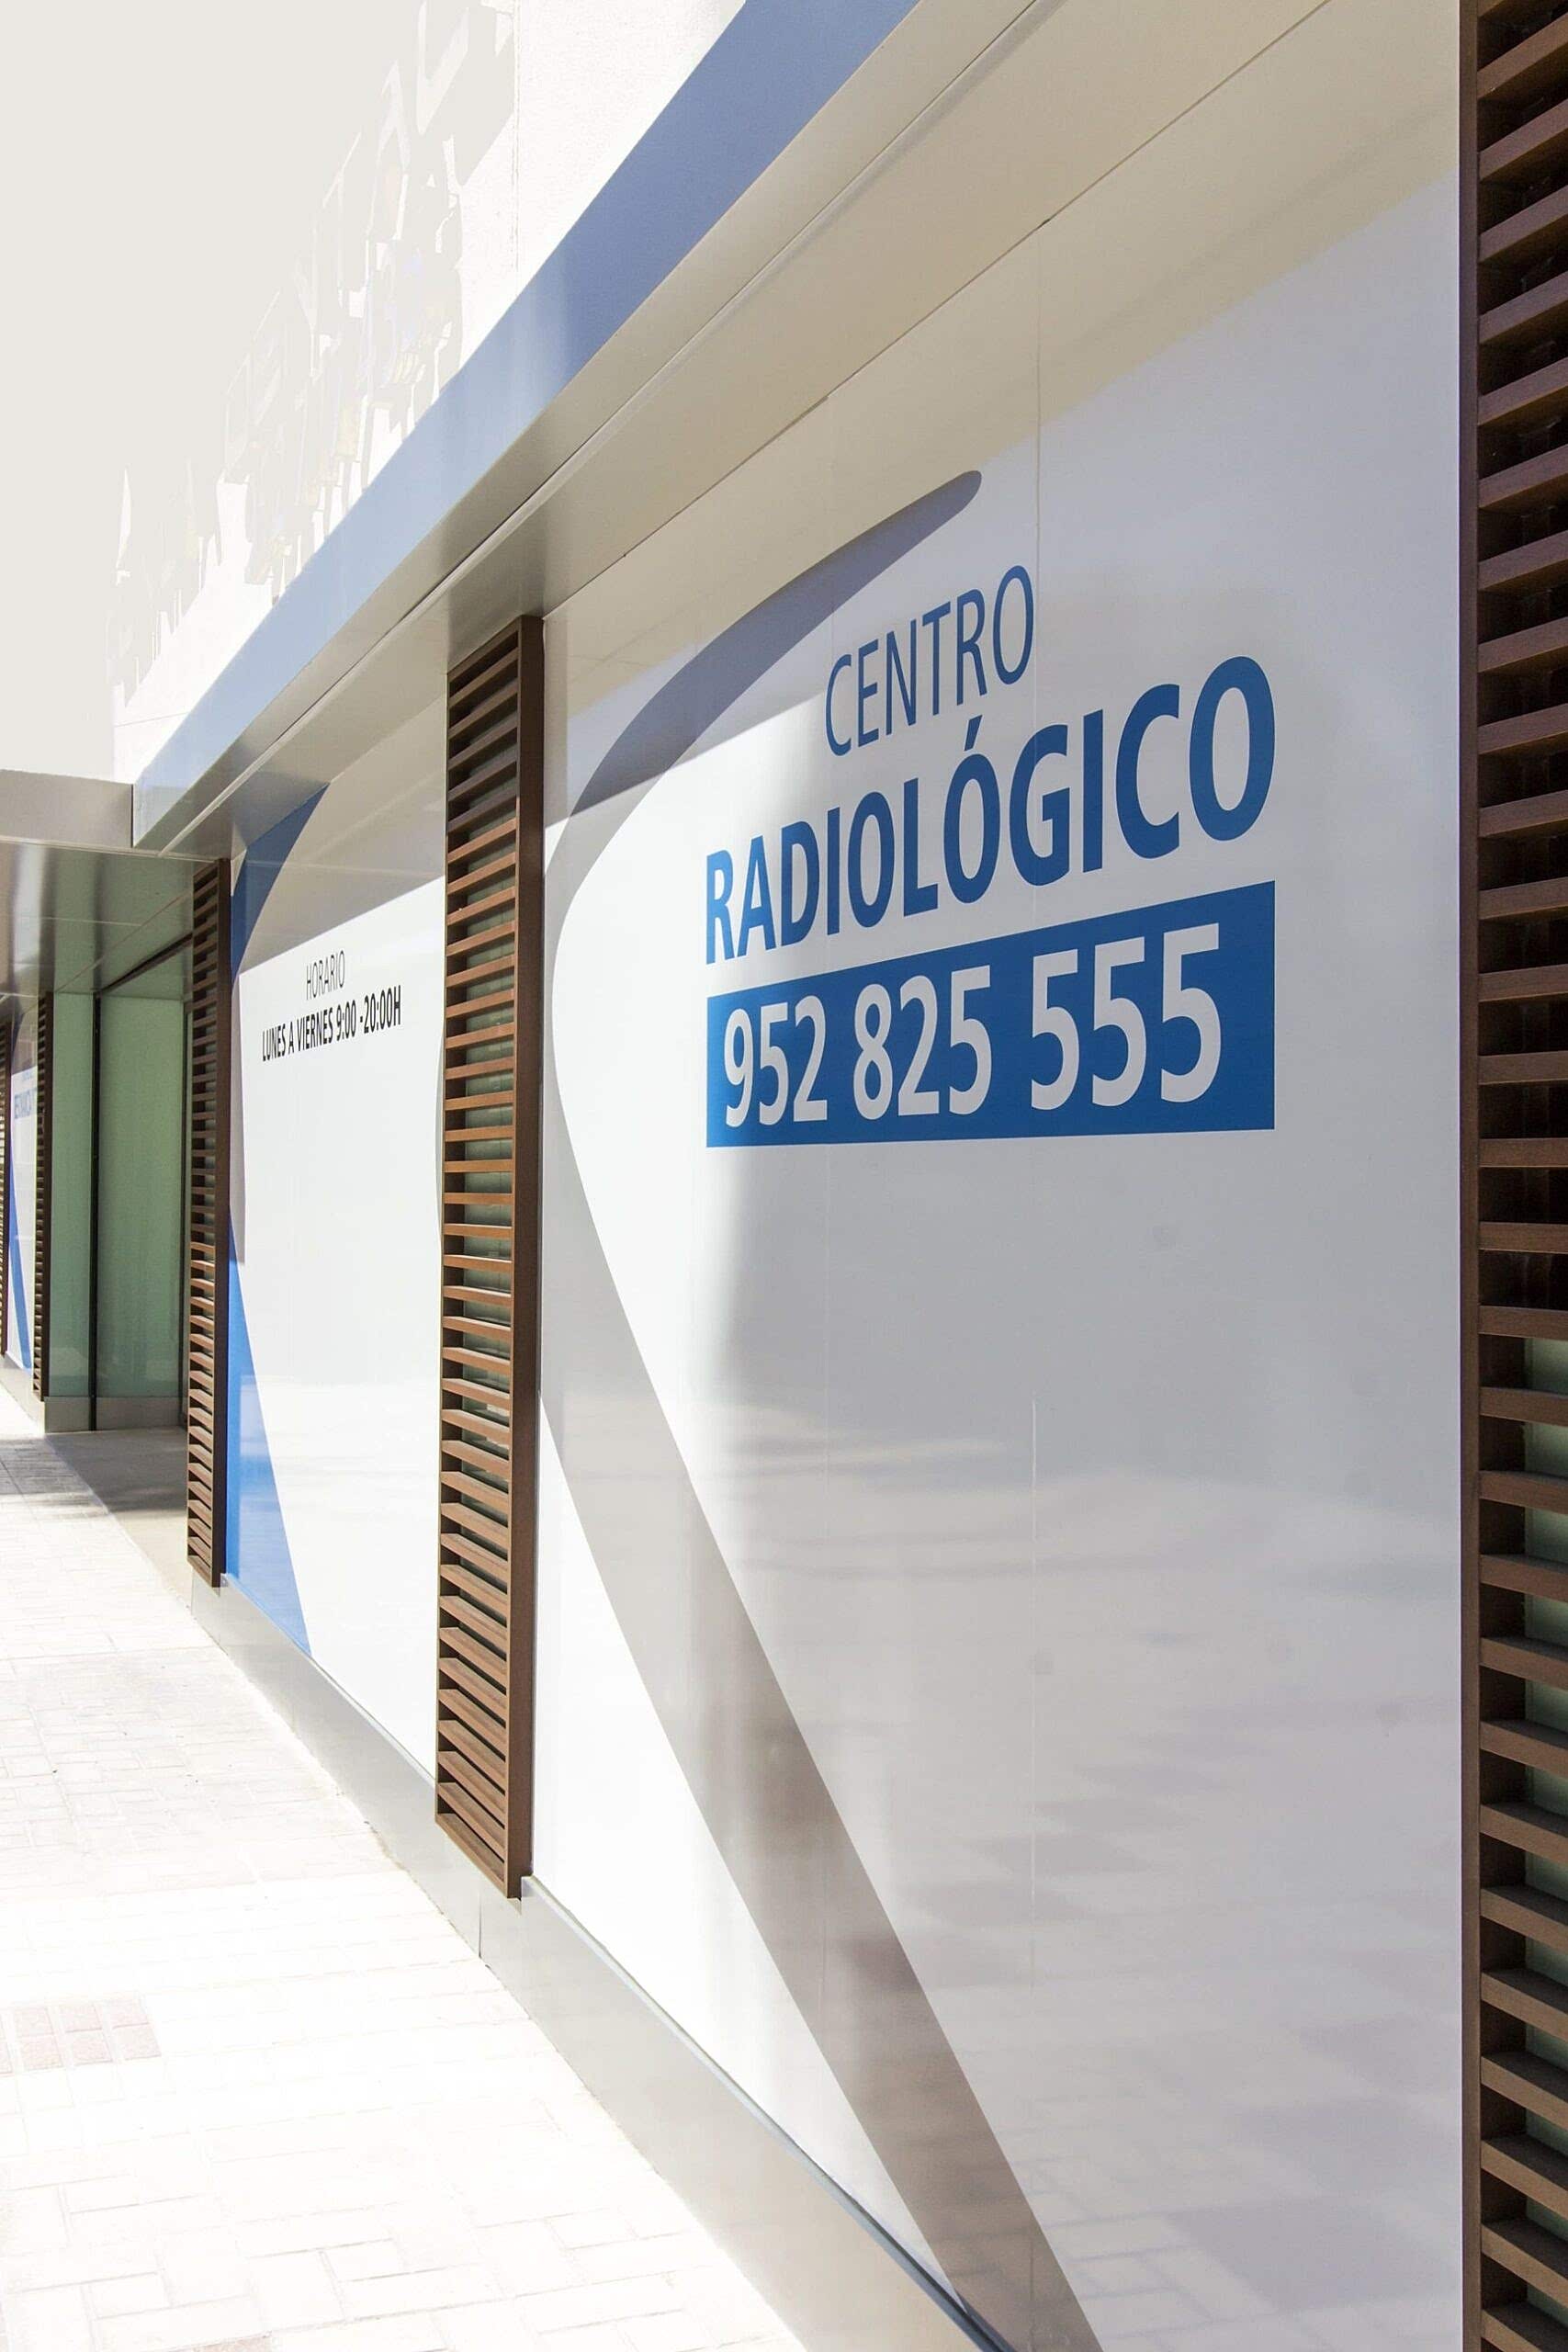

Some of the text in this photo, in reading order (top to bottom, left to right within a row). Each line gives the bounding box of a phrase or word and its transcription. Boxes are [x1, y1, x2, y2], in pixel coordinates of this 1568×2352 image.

[826, 565, 1033, 756] CENTRO
[706, 656, 1275, 965] RADIOLÓGICO
[262, 1023, 286, 1062] LUNES
[288, 1021, 295, 1055] A
[297, 1007, 333, 1051] VIERNES
[336, 1000, 356, 1041] 9:00
[306, 950, 345, 1000] HORARIO
[724, 922, 1222, 1128] 952 825 555
